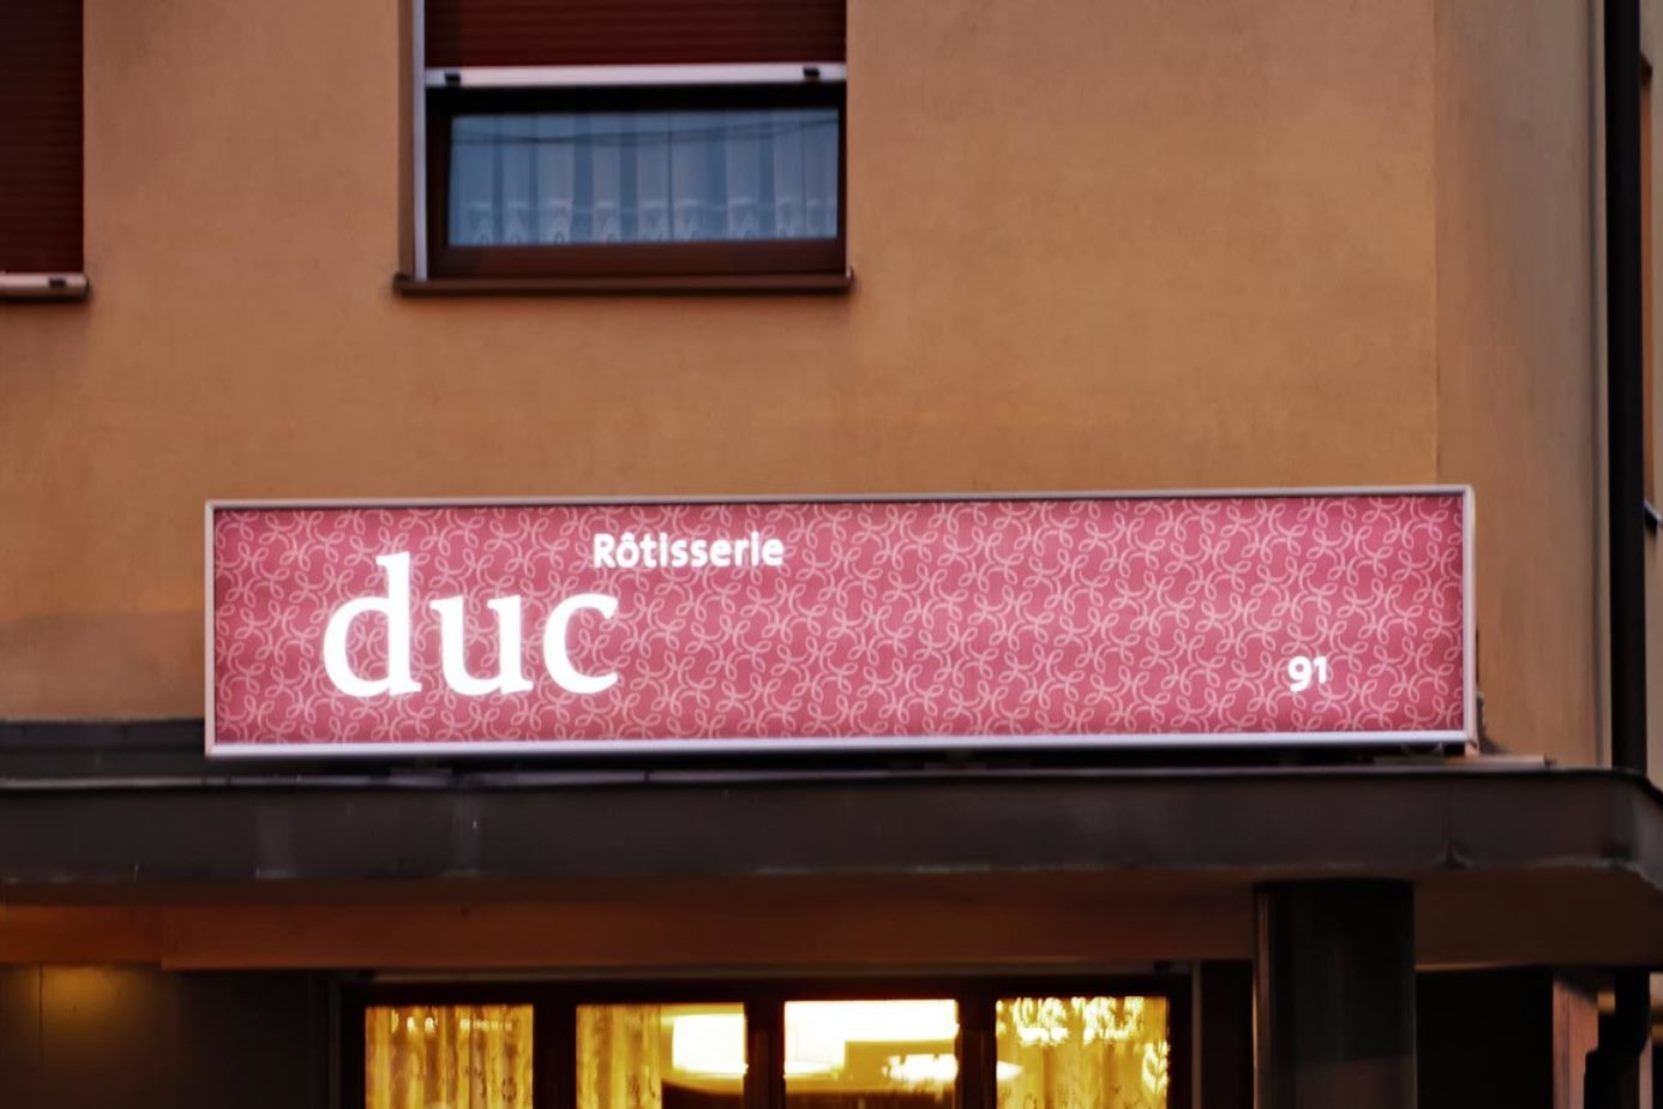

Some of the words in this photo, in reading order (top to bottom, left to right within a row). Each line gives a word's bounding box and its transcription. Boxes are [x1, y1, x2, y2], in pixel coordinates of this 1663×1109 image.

[593, 531, 785, 569] Rôtisserie
[323, 550, 619, 698] duc
[1287, 655, 1328, 693] 91
